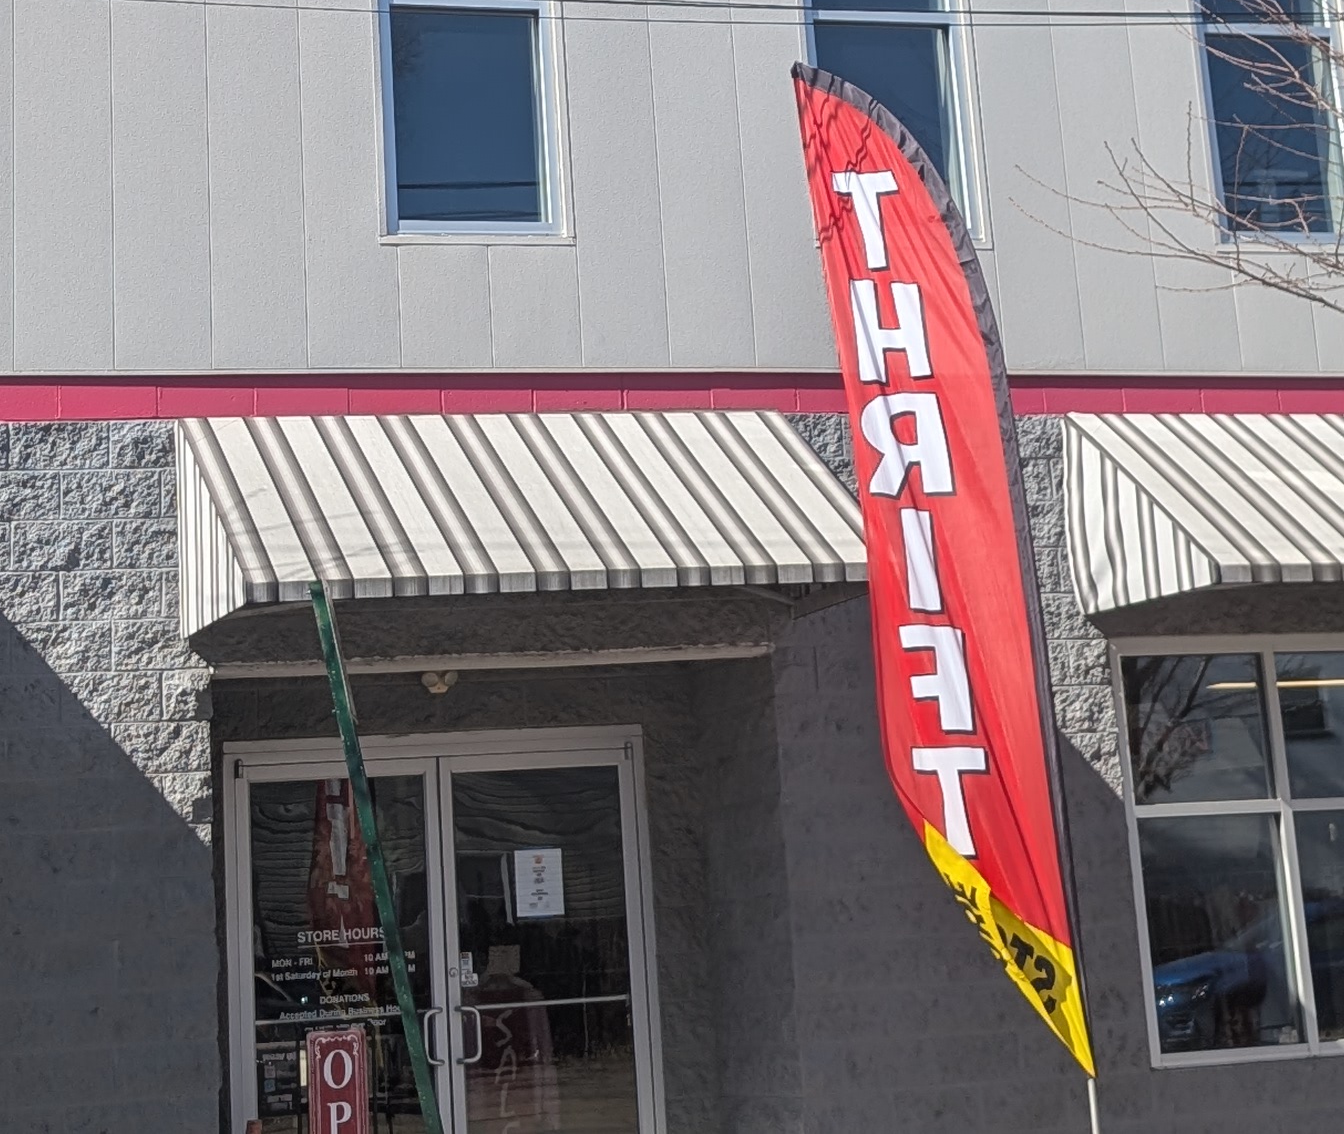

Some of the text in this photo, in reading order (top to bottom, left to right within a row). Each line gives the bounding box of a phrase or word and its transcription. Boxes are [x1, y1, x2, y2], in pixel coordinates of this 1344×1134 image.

[297, 927, 385, 943] STORE HOURS
[271, 959, 292, 968] MON
[299, 957, 313, 966] FRI
[319, 993, 370, 1004] DONATIONS
